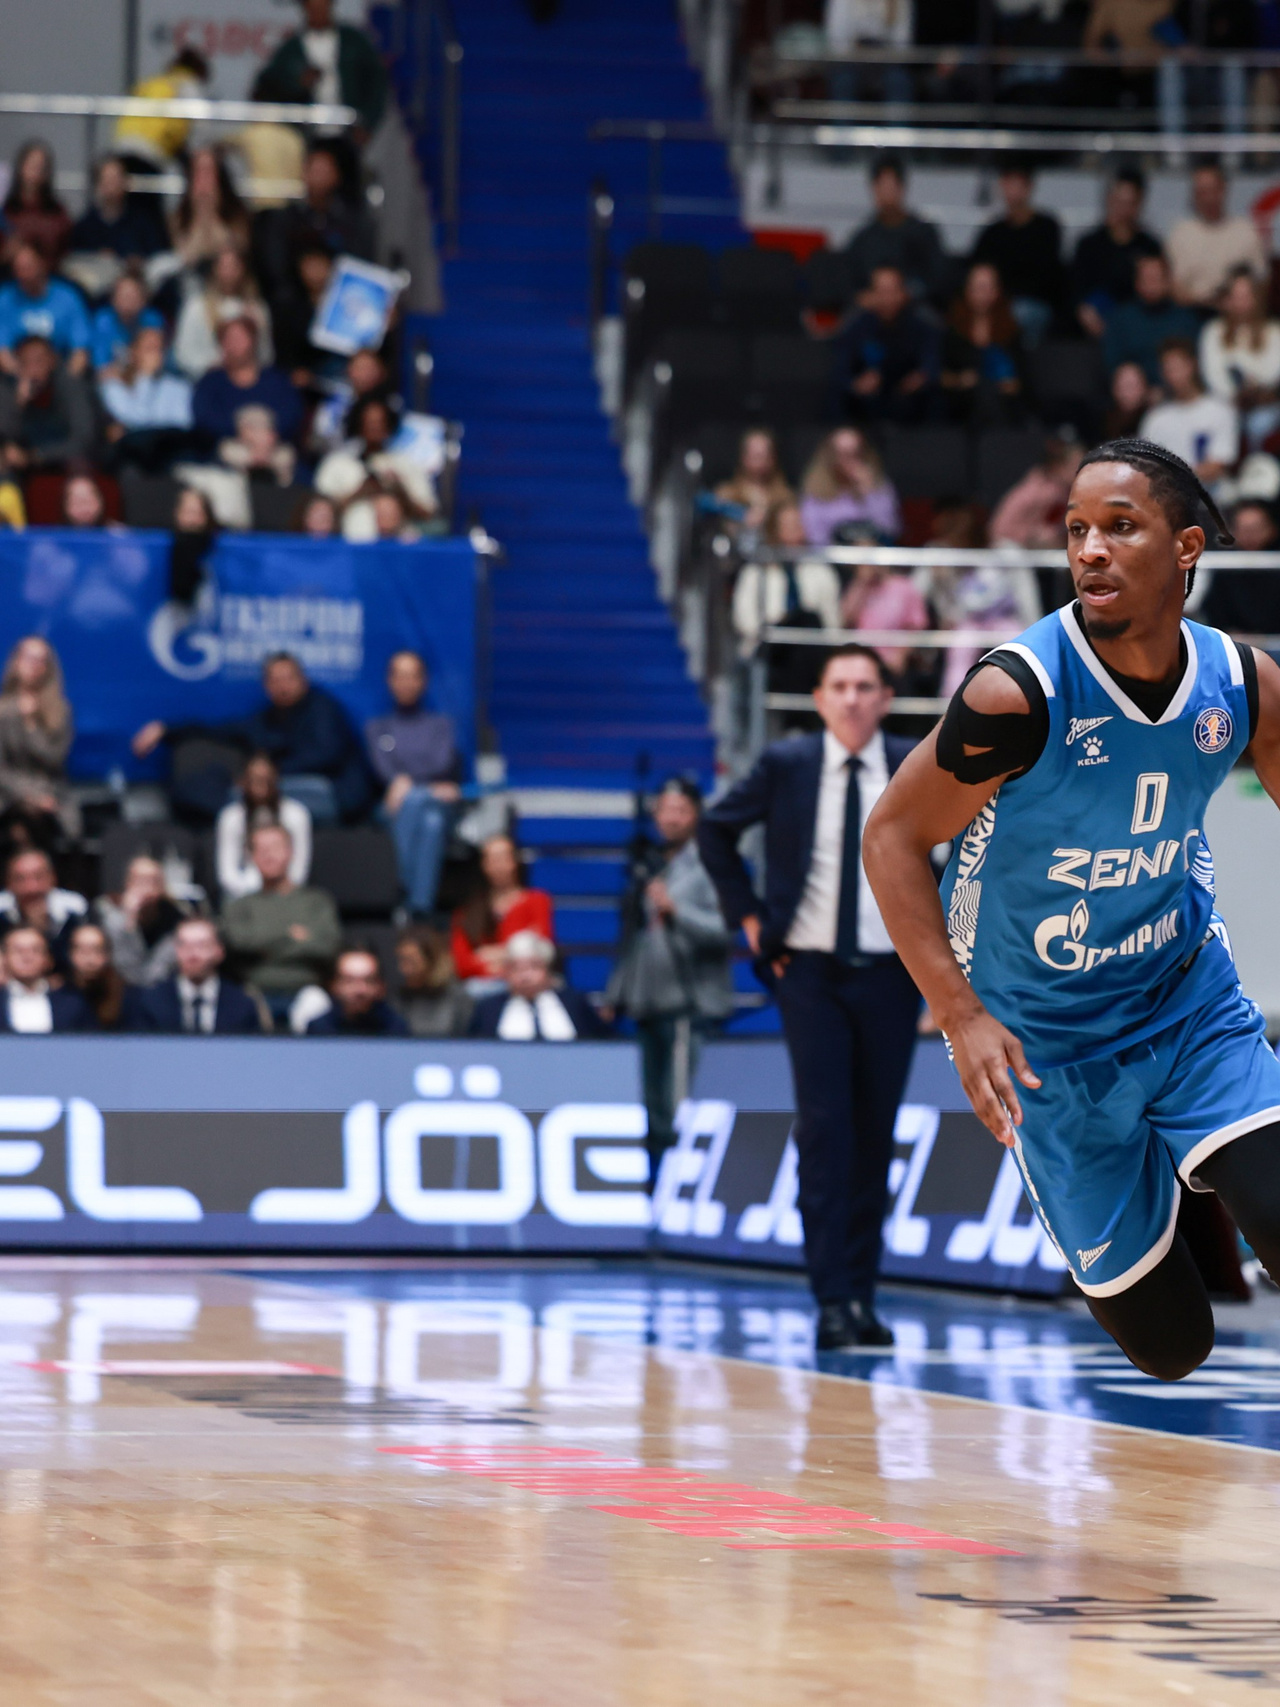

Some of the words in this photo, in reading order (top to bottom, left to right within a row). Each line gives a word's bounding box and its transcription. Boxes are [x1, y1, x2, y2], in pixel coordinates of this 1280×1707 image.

[1077, 755, 1110, 767] KELME
[1130, 772, 1169, 835] 0
[1083, 909, 1178, 973] ГПРОМ
